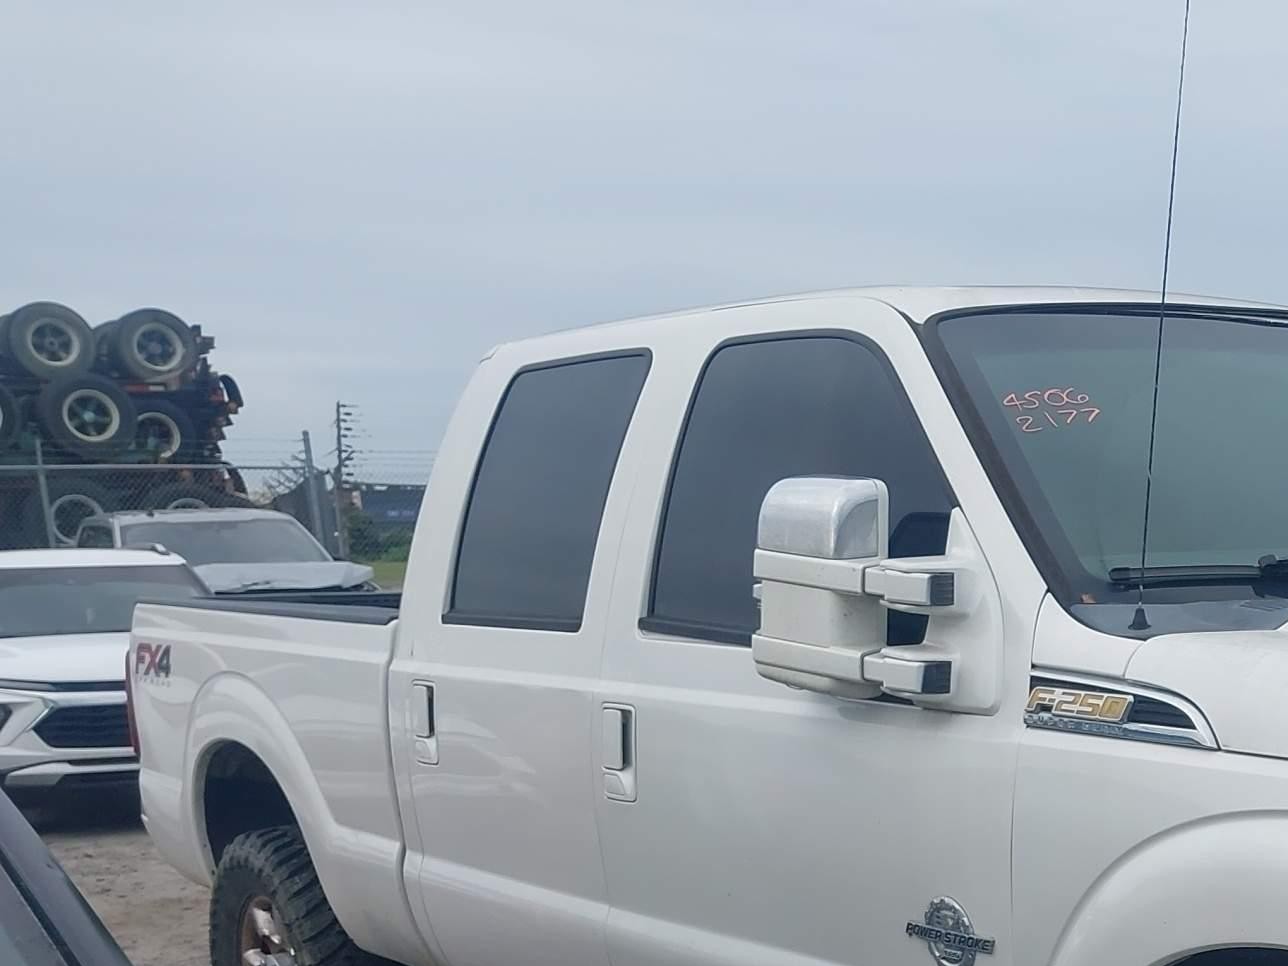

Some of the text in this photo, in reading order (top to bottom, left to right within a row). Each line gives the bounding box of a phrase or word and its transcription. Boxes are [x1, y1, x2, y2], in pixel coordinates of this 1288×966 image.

[1003, 387, 1089, 411] 4506
[1016, 407, 1101, 432] 2177
[135, 642, 172, 678] FX4
[1025, 686, 1135, 722] F-250
[906, 922, 995, 952] POWER STROKE
